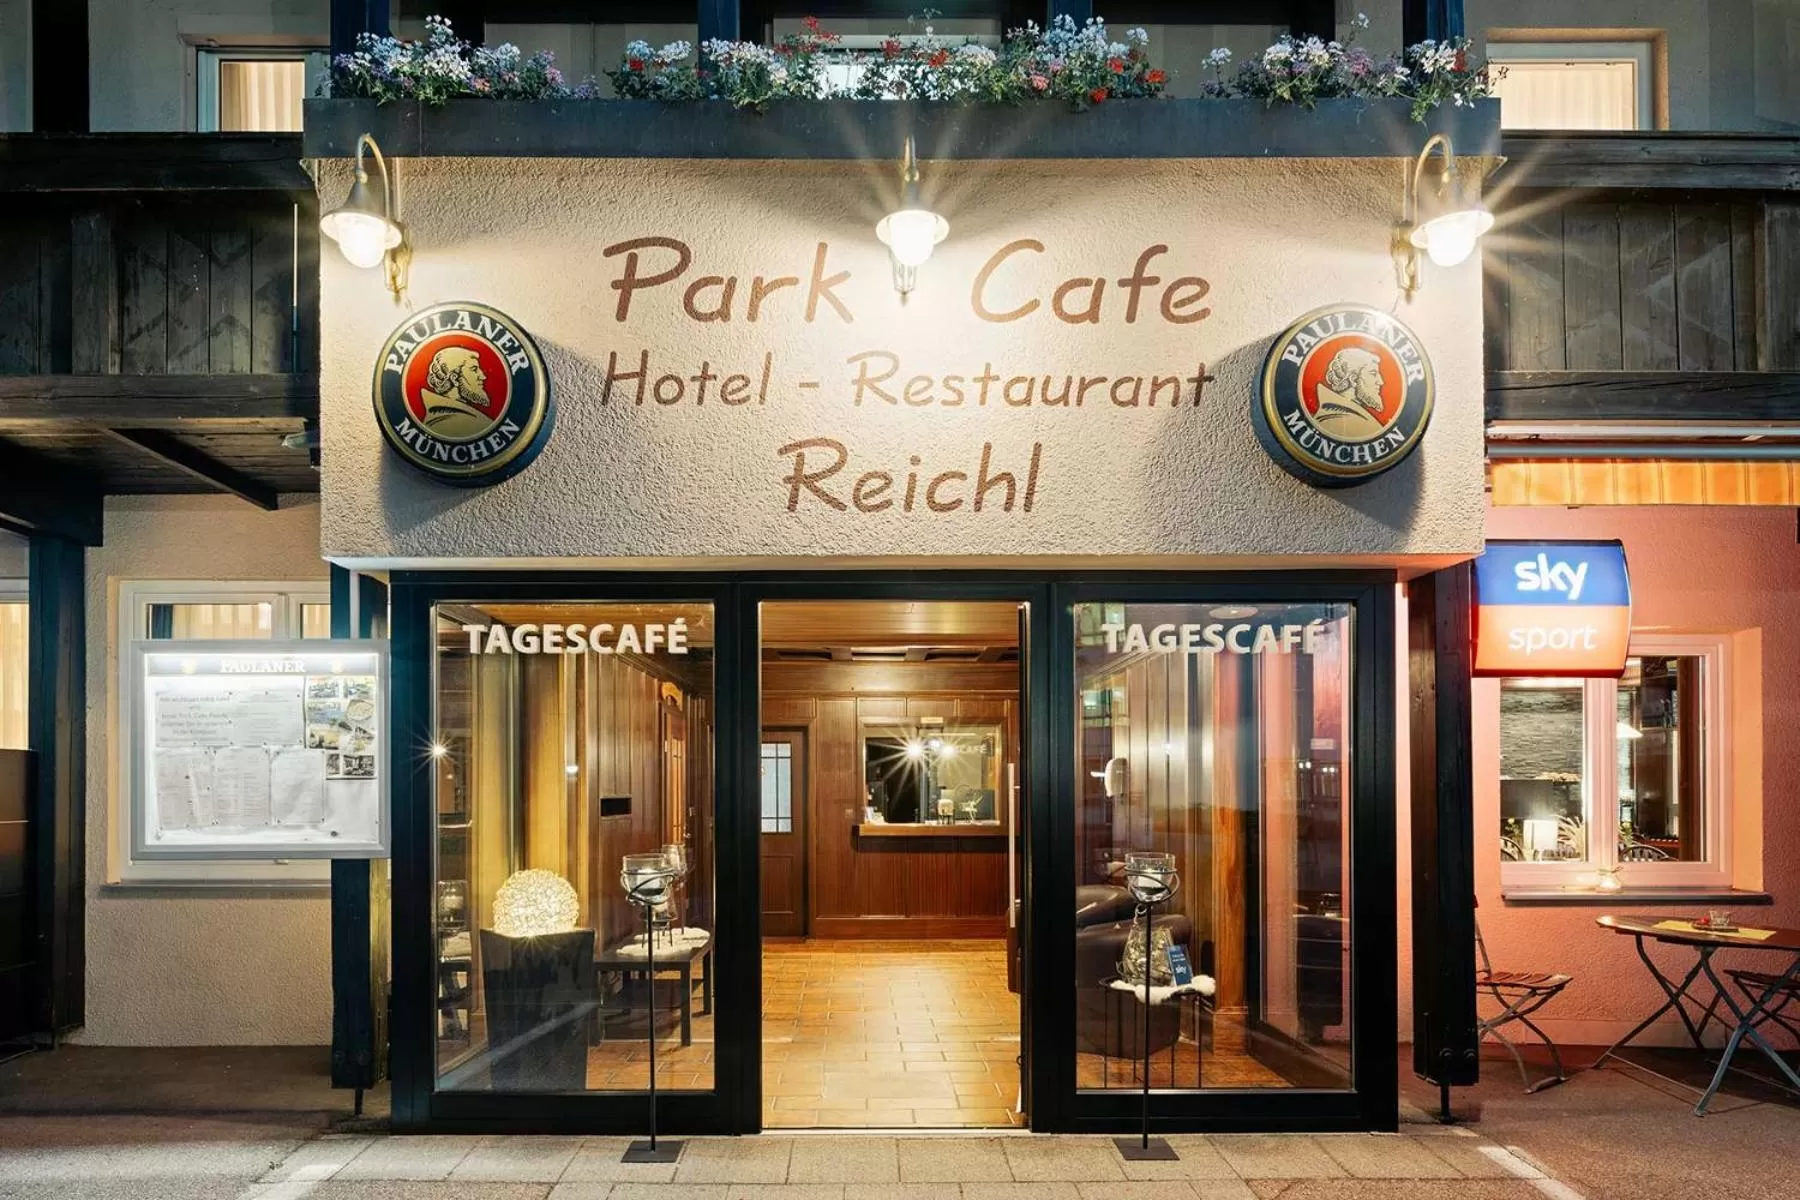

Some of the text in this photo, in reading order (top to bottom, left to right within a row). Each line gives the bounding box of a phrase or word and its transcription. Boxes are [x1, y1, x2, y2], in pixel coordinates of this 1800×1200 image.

[603, 236, 1212, 325] Park Cafe
[384, 310, 529, 375] PAULANER
[1281, 312, 1424, 386] PAULANER
[602, 350, 772, 407] Hotel
[847, 351, 1214, 409] Restaurant
[395, 417, 521, 463] MÜNCHEN
[1283, 409, 1406, 463] MÜNCHEN
[777, 437, 1042, 513] Reichl
[1514, 553, 1588, 600] sky
[462, 617, 688, 655] TAGESCAFÉ
[1101, 618, 1325, 655] TAGESCAFÉ
[1508, 625, 1597, 655] sport
